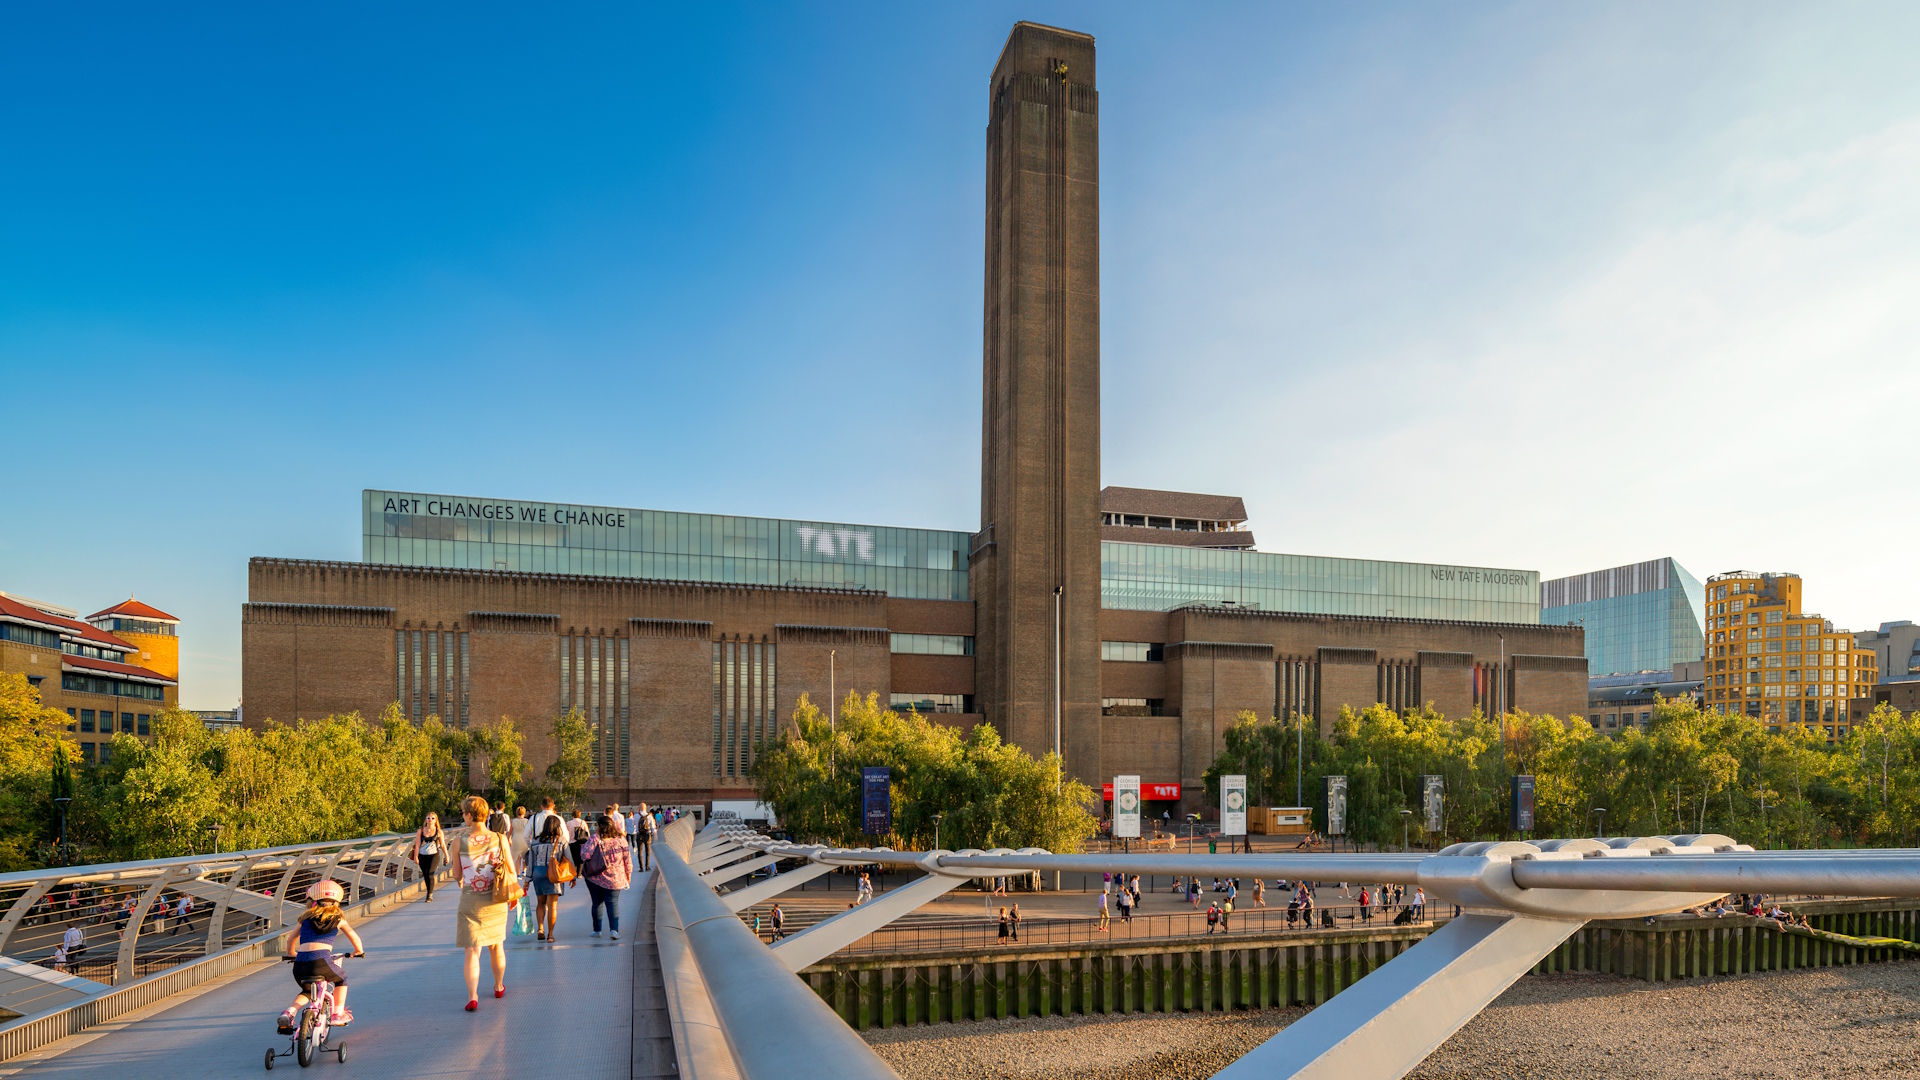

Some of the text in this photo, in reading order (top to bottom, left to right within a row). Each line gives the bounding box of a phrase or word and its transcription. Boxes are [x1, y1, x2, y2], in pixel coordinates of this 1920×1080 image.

[384, 497, 626, 528] ART CHANGES WE CHANGE
[795, 526, 874, 561] TATE
[1431, 569, 1529, 586] NEW TATE MODERN
[1154, 786, 1178, 797] TATE
[859, 991, 938, 1005] WHAT
[976, 989, 1004, 1001] IS
[1041, 984, 1090, 995] THE
